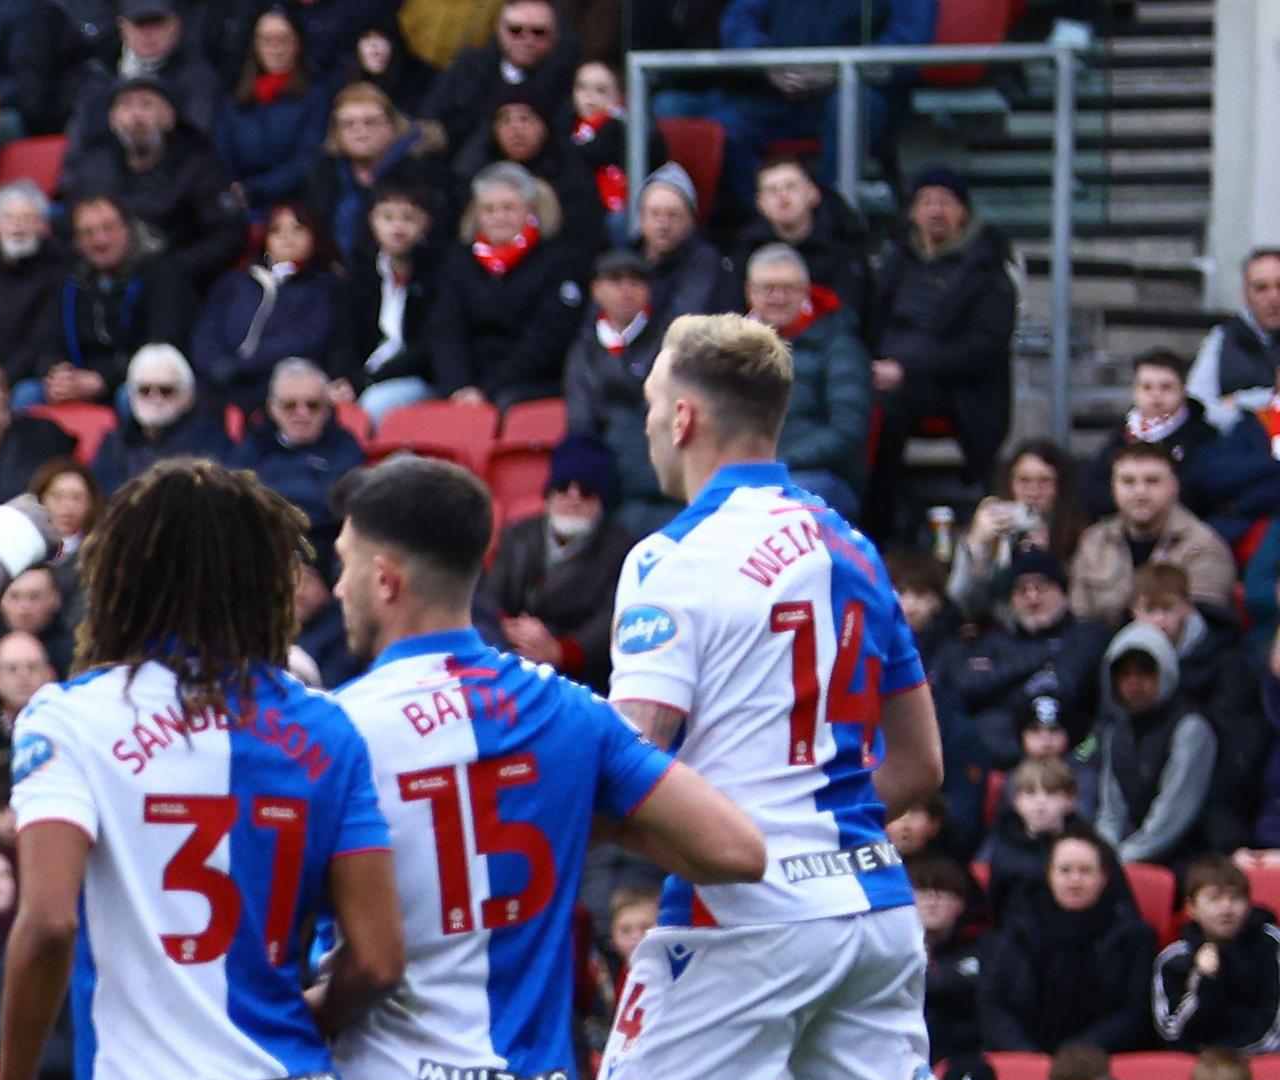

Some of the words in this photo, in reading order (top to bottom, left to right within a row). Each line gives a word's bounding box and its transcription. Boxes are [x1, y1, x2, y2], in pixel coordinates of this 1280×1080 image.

[770, 600, 884, 768] 14
[144, 794, 308, 967] 31
[397, 752, 556, 935] 15
